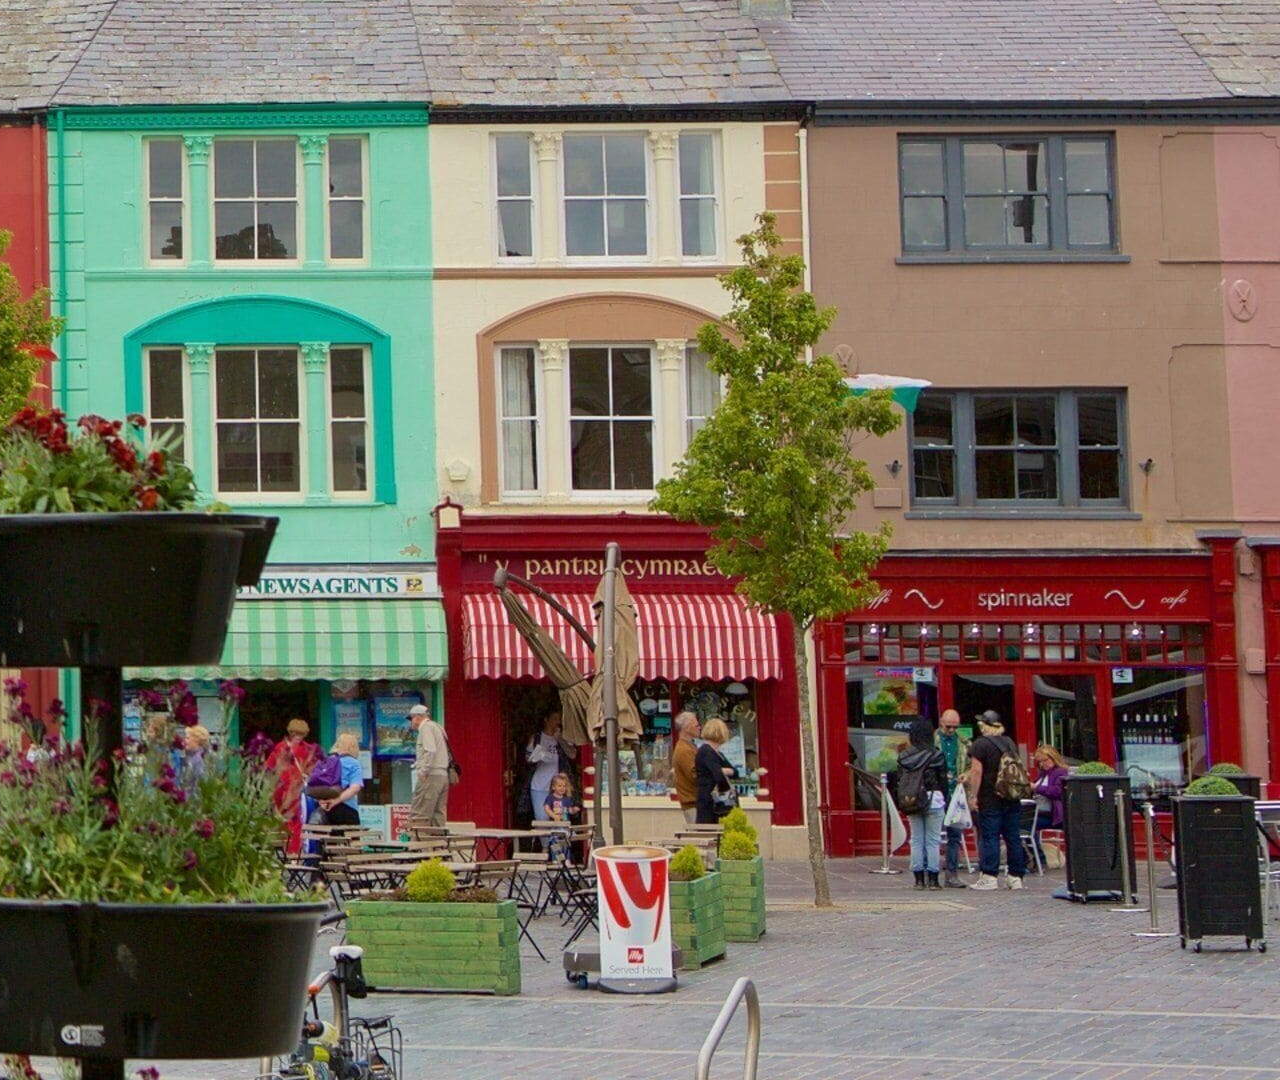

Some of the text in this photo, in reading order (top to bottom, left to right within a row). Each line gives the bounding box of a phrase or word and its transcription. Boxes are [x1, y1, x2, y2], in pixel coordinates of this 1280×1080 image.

[248, 577, 398, 594] NEWSAGENTS
[978, 588, 1074, 611] spinnaker
[608, 964, 664, 975] Served Here
